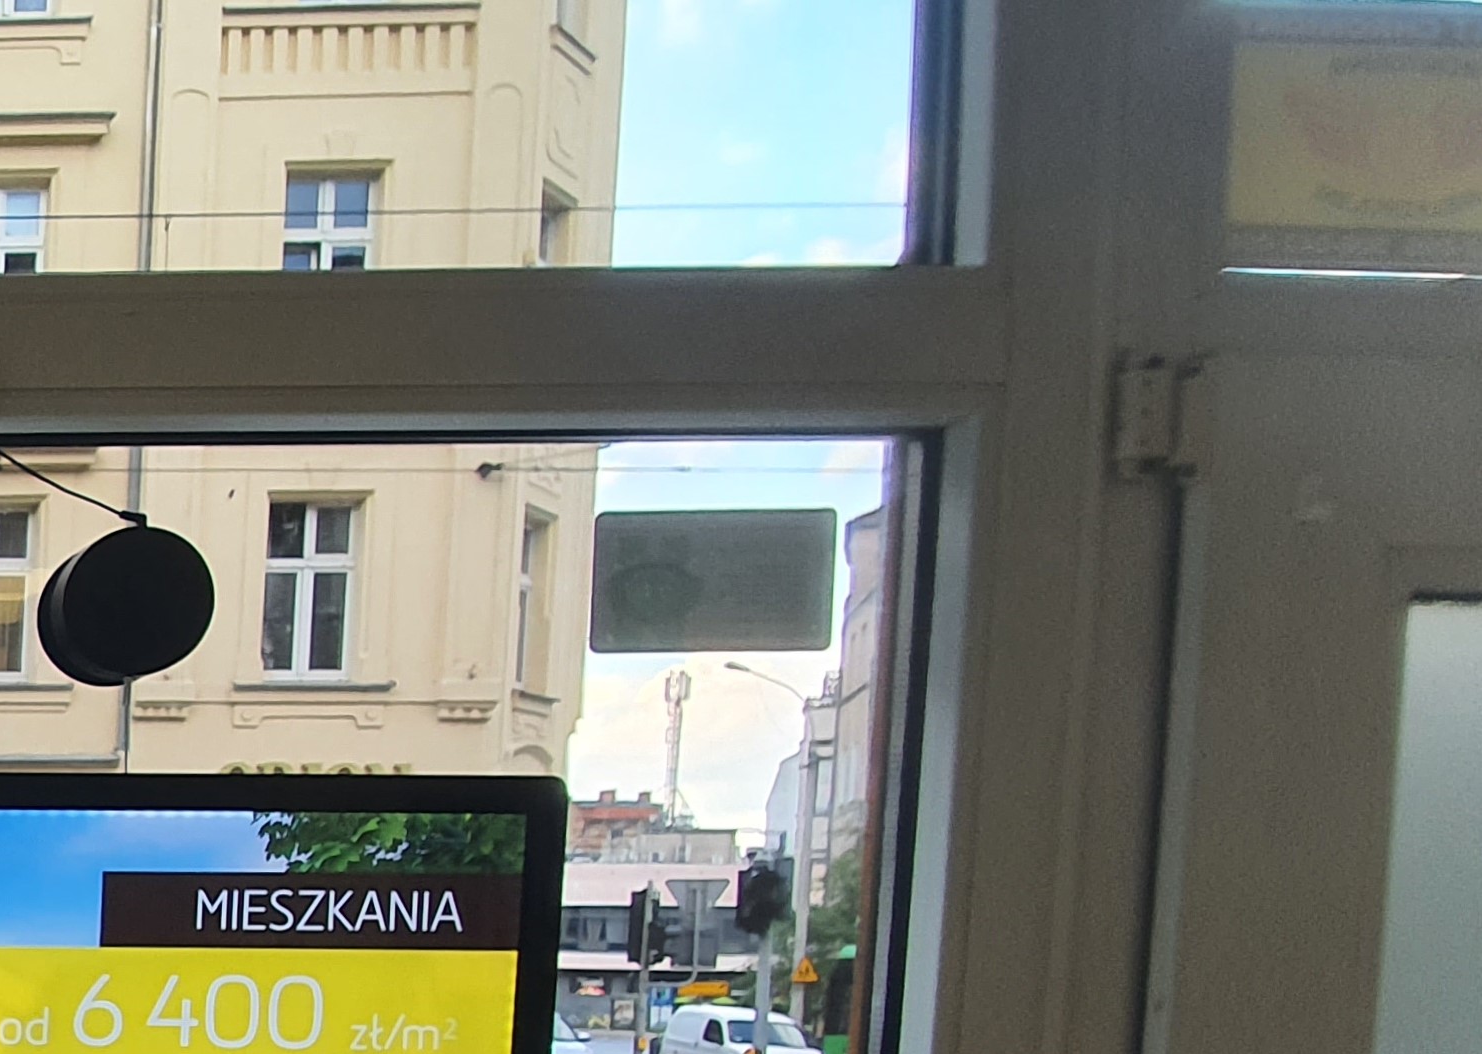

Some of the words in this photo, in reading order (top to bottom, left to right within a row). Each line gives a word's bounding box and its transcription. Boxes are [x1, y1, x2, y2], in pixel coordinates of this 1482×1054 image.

[195, 888, 464, 933] MIESZKANIA
[72, 973, 124, 1047] 6
[146, 974, 325, 1051] 400
